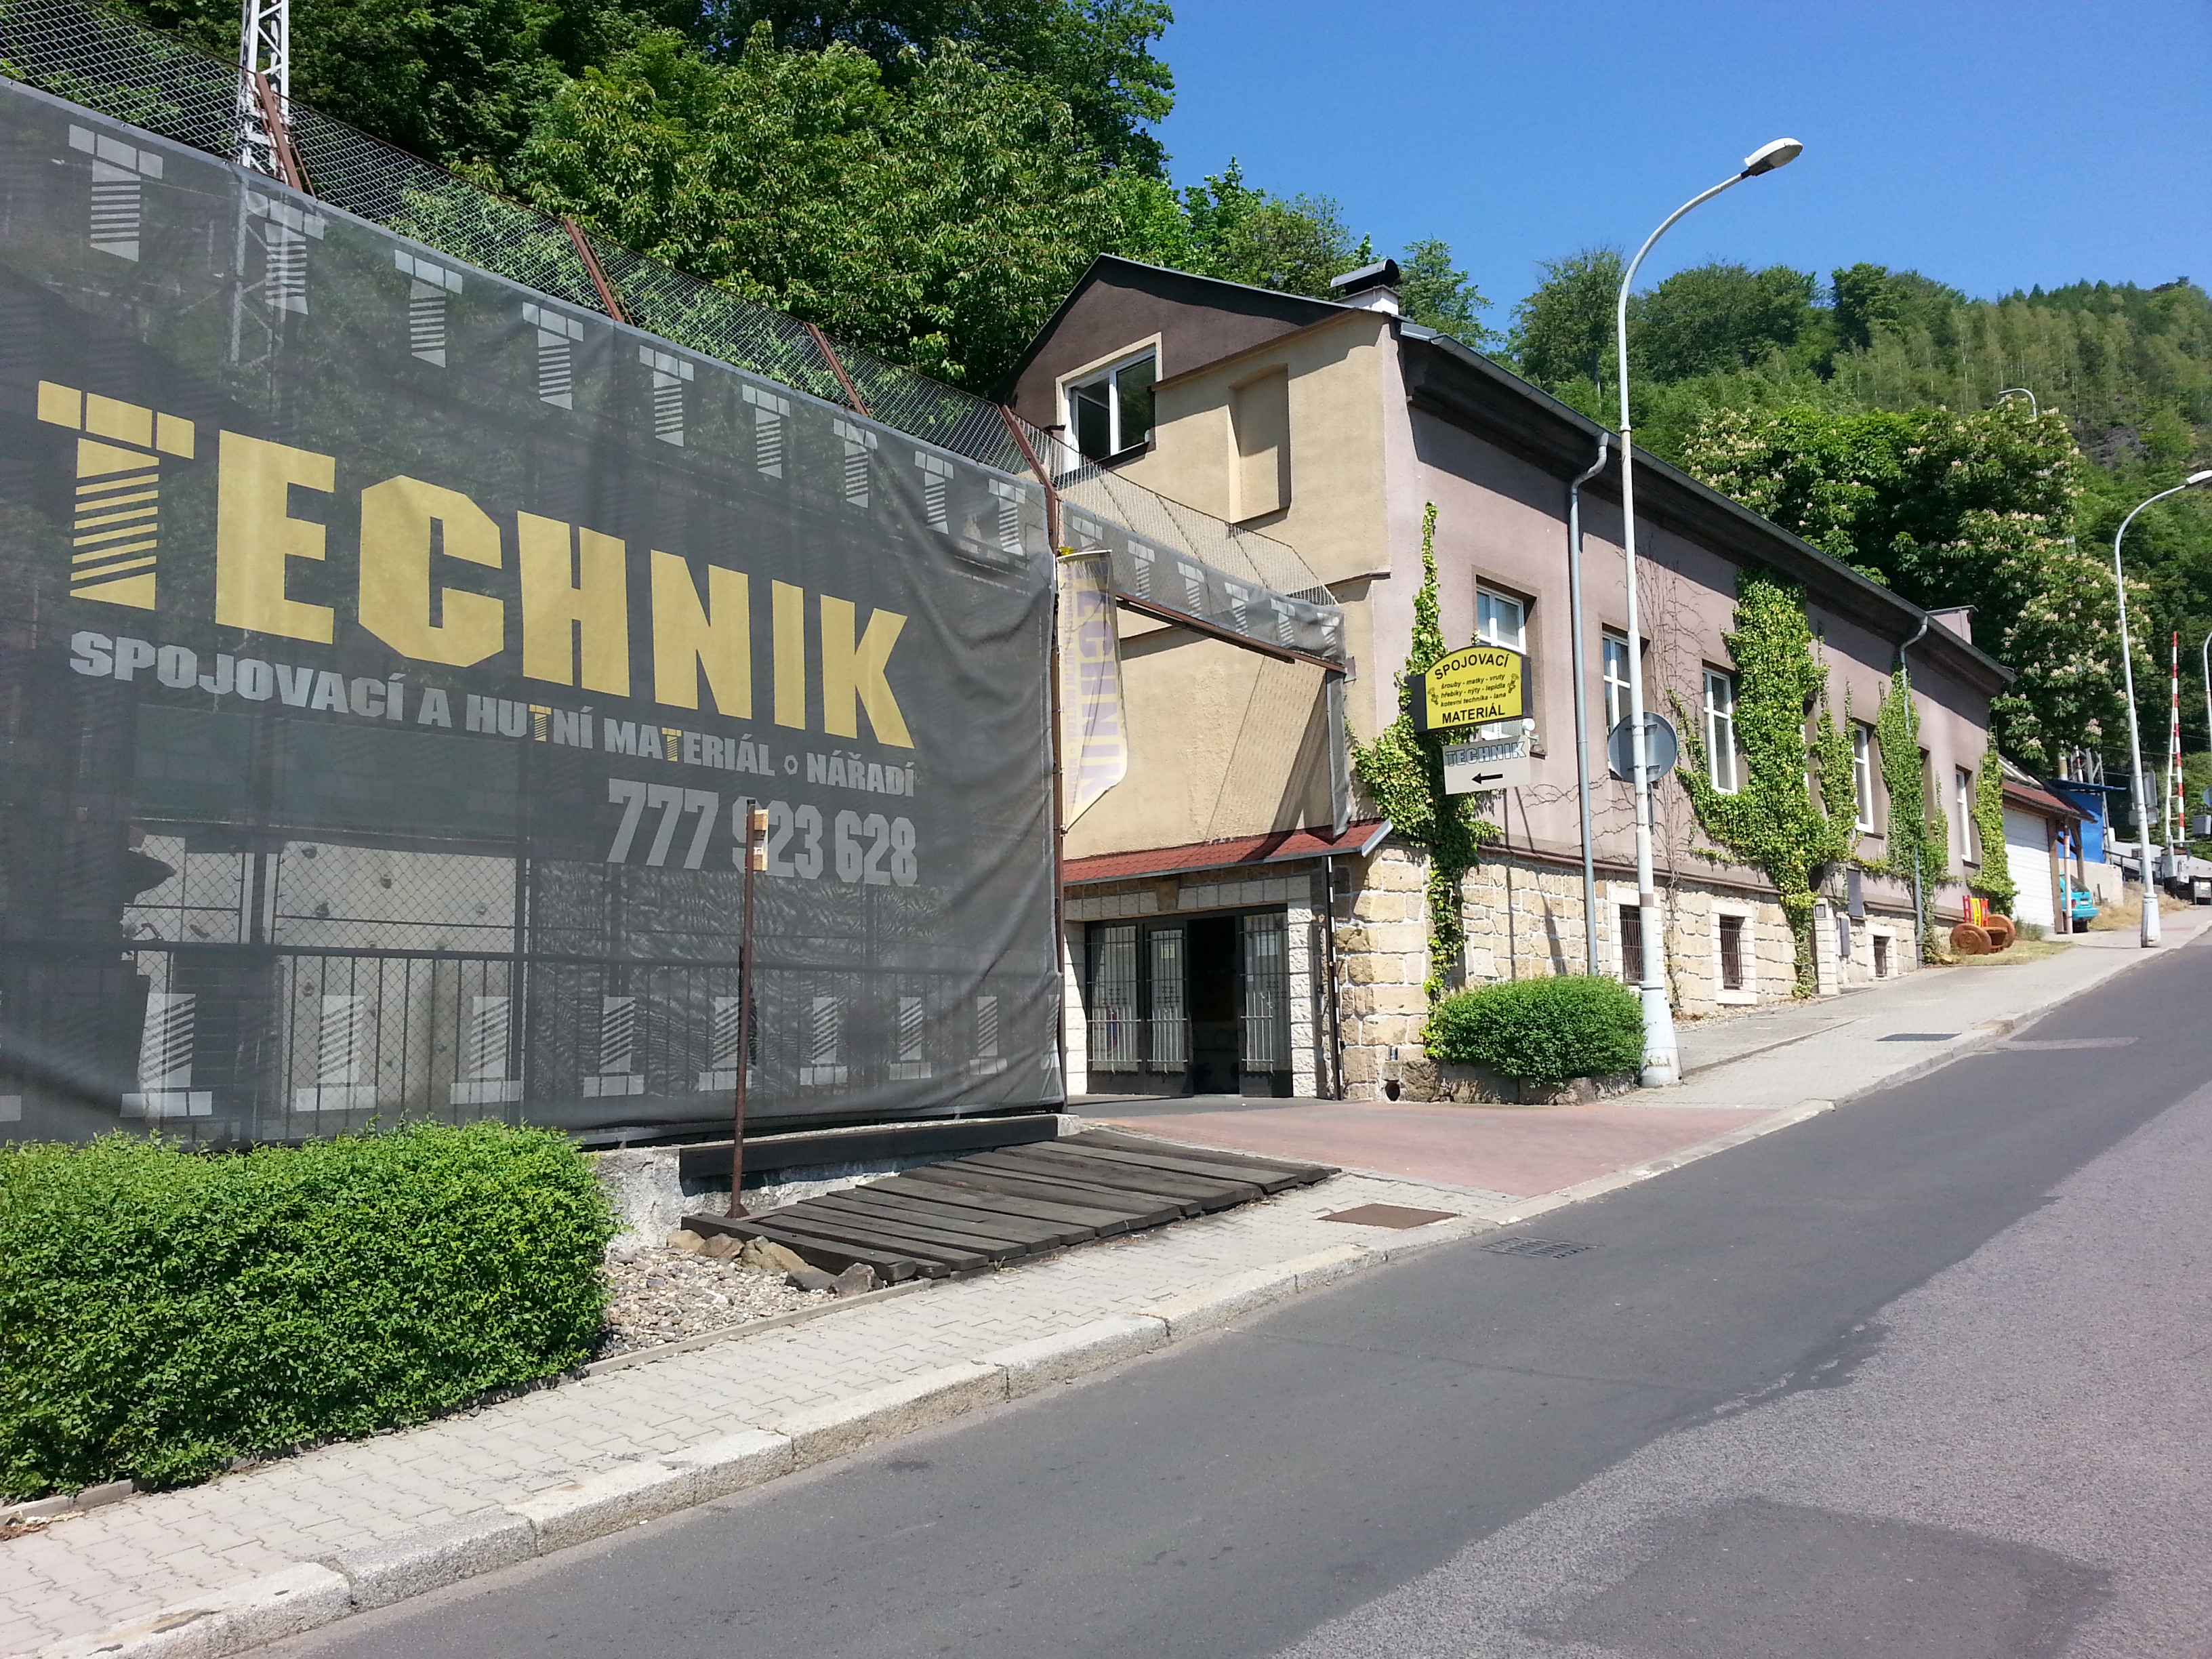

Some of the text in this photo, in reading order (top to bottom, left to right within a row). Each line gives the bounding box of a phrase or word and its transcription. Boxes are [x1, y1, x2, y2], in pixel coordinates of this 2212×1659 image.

[38, 380, 914, 750] TECHNIK
[1435, 653, 1510, 680] SPOJOVACÍ
[1441, 681, 1462, 689] šrouby
[1486, 682, 1506, 691] lepidla
[70, 630, 914, 797] SPOJOVACÍ A HUTNÍ MATERIÁL NÁŘADÍ
[1441, 699, 1462, 707] kotevní
[1463, 695, 1488, 703] technika
[1442, 703, 1506, 724] MATERIÁL
[1446, 741, 1526, 767] TECHNIK
[607, 777, 720, 870] 777
[834, 810, 918, 887] 628
